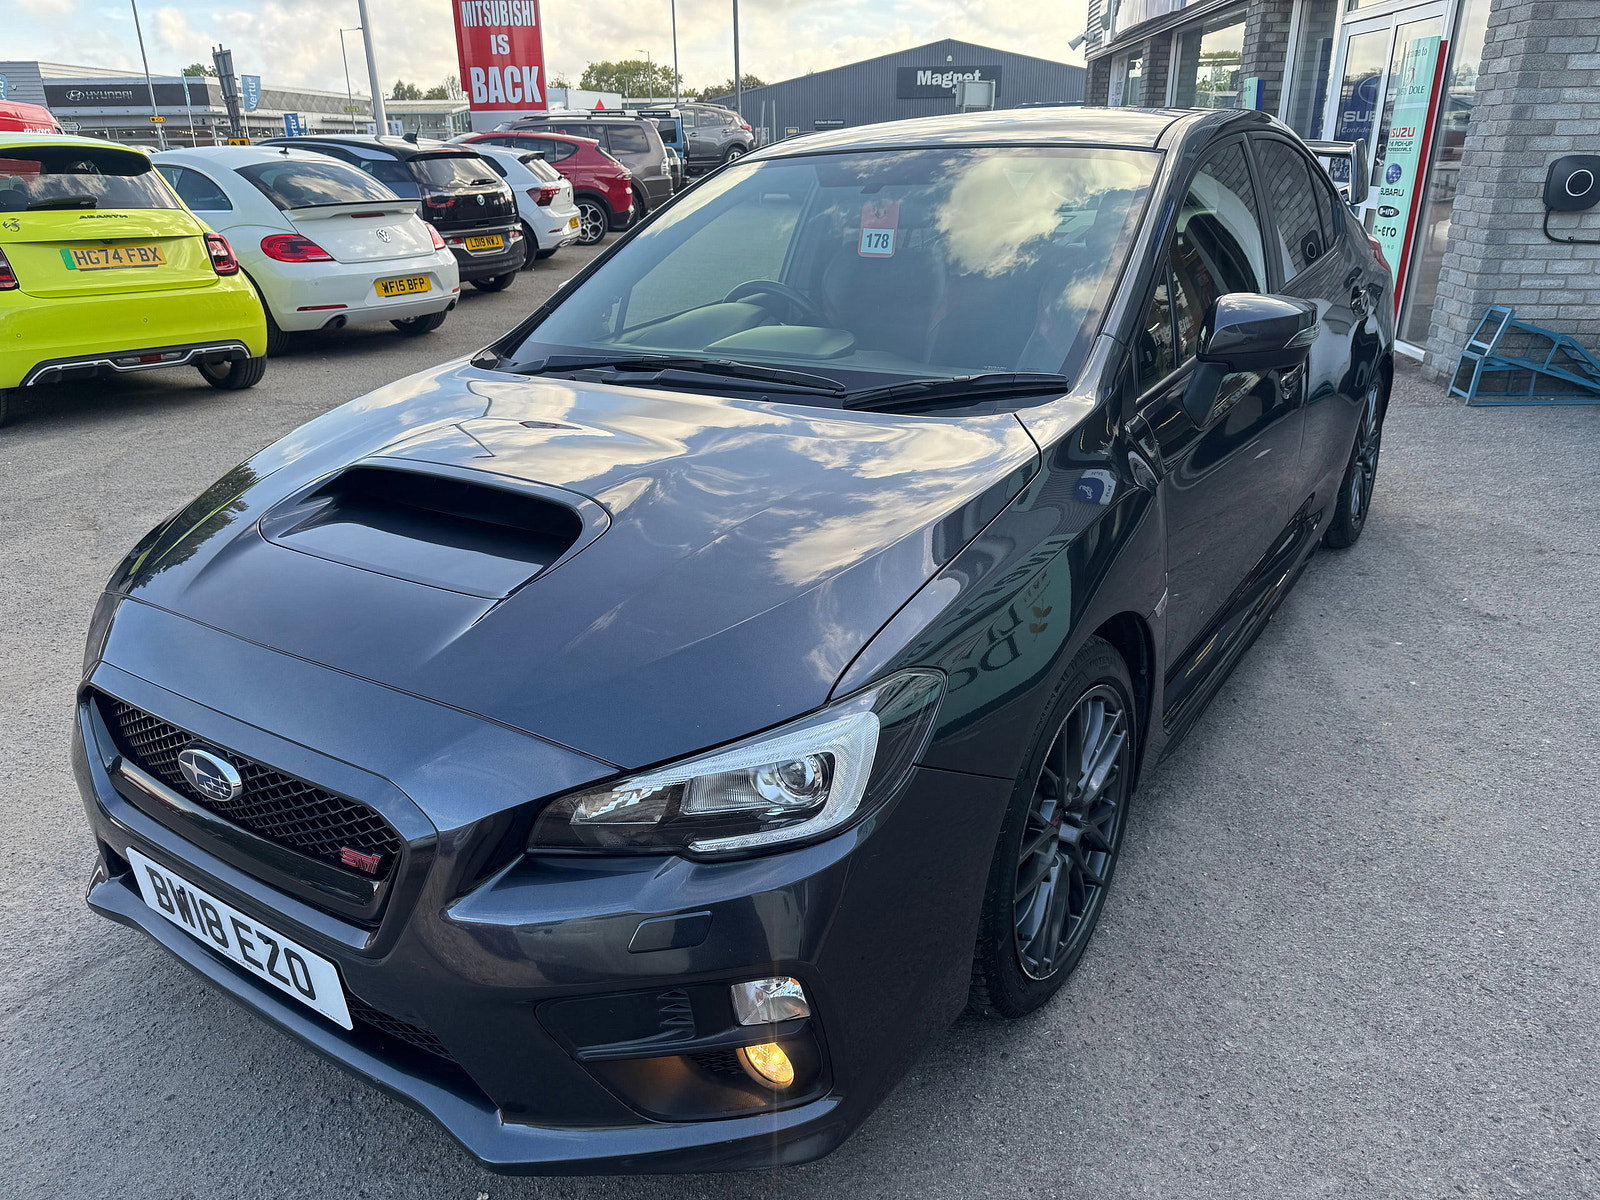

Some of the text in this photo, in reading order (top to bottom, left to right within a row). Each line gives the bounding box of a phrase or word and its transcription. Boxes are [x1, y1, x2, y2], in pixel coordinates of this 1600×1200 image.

[461, 0, 536, 28] MITSUBISHI
[490, 34, 510, 55] IS
[470, 65, 543, 104] BACK
[916, 69, 981, 88] Magnet
[85, 90, 133, 100] HYUNDAI
[1408, 85, 1425, 95] DOLE
[1343, 110, 1376, 122] SUB
[1380, 187, 1404, 197] SUBARU
[486, 236, 500, 246] NWJ
[866, 233, 889, 249] 178
[73, 247, 162, 266] HG74 FBX
[381, 277, 425, 294] WF15 BFP
[144, 864, 316, 1001] BW18 EZO
